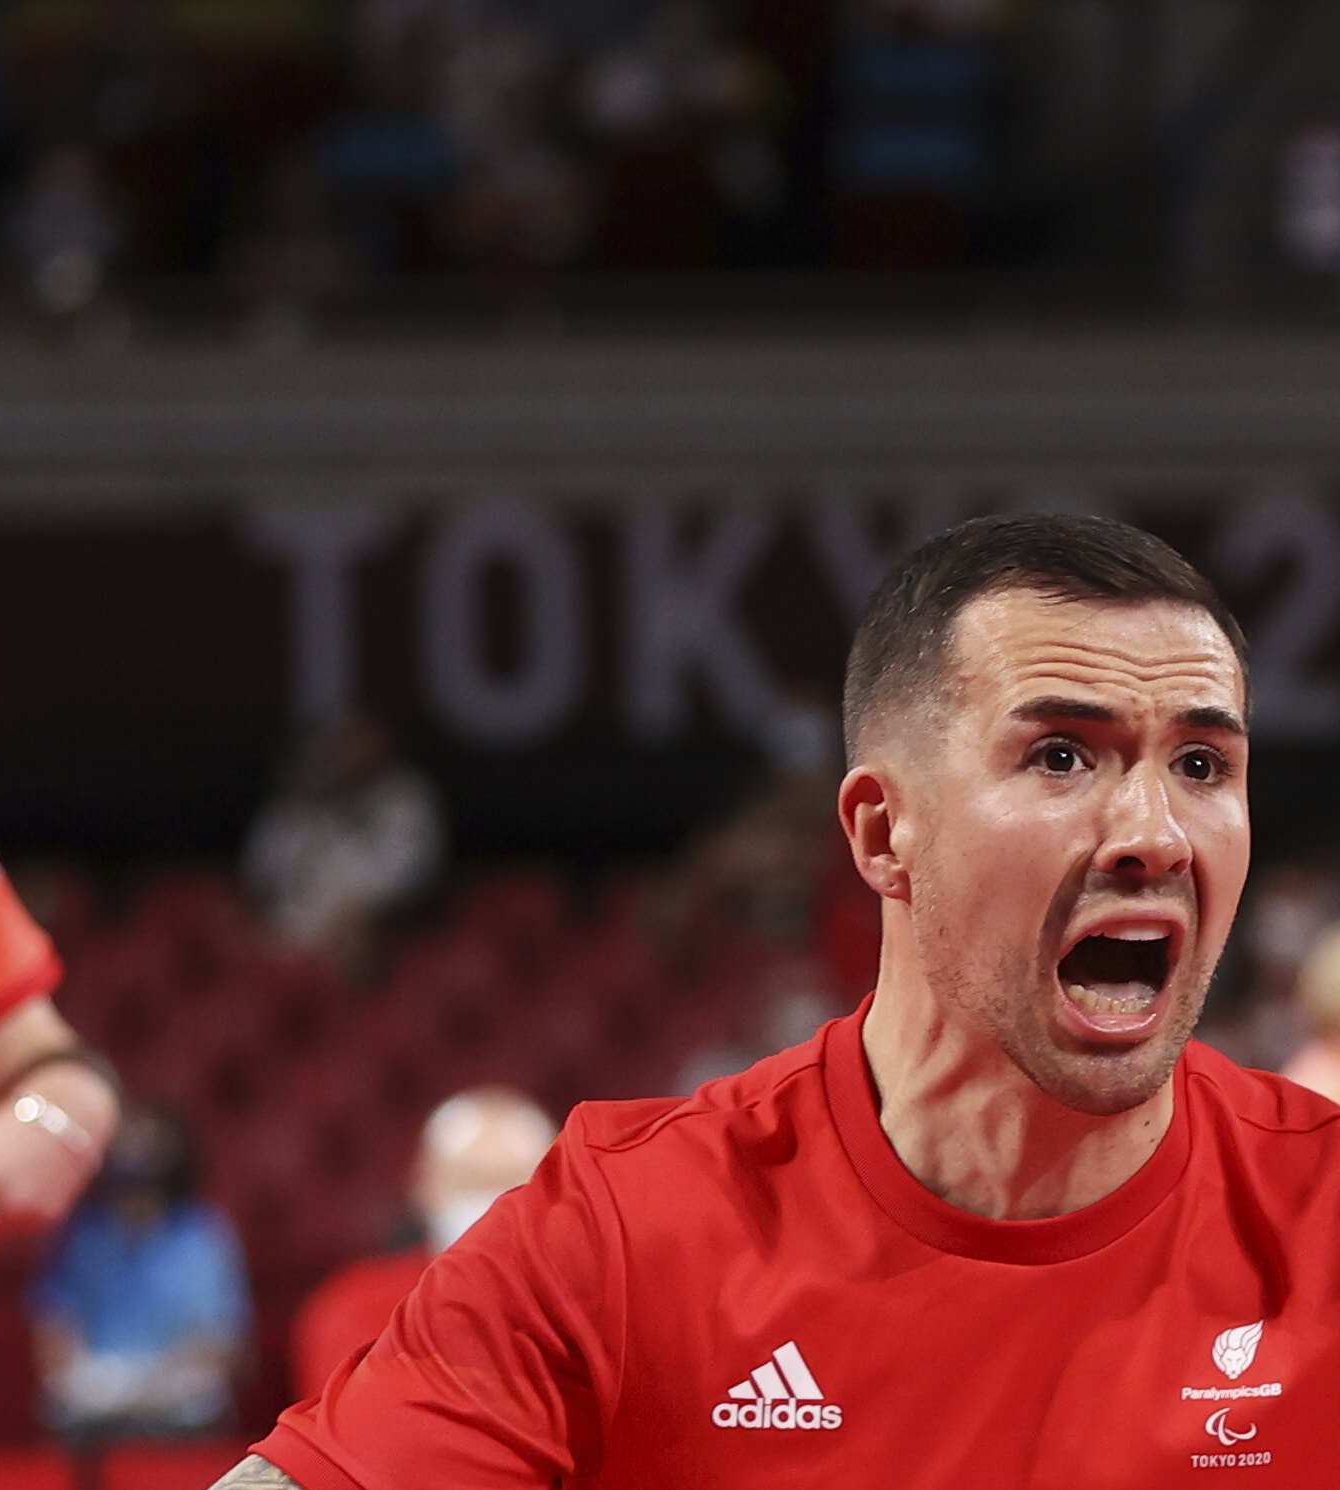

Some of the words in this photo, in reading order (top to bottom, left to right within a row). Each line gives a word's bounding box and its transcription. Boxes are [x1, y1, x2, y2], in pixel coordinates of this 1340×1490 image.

[242, 497, 960, 750] TOKY
[1181, 1382, 1282, 1400] ParalympicsGB
[711, 1397, 843, 1430] adidas
[1190, 1454, 1237, 1468] TOKYO
[1238, 1451, 1271, 1466] 2020
